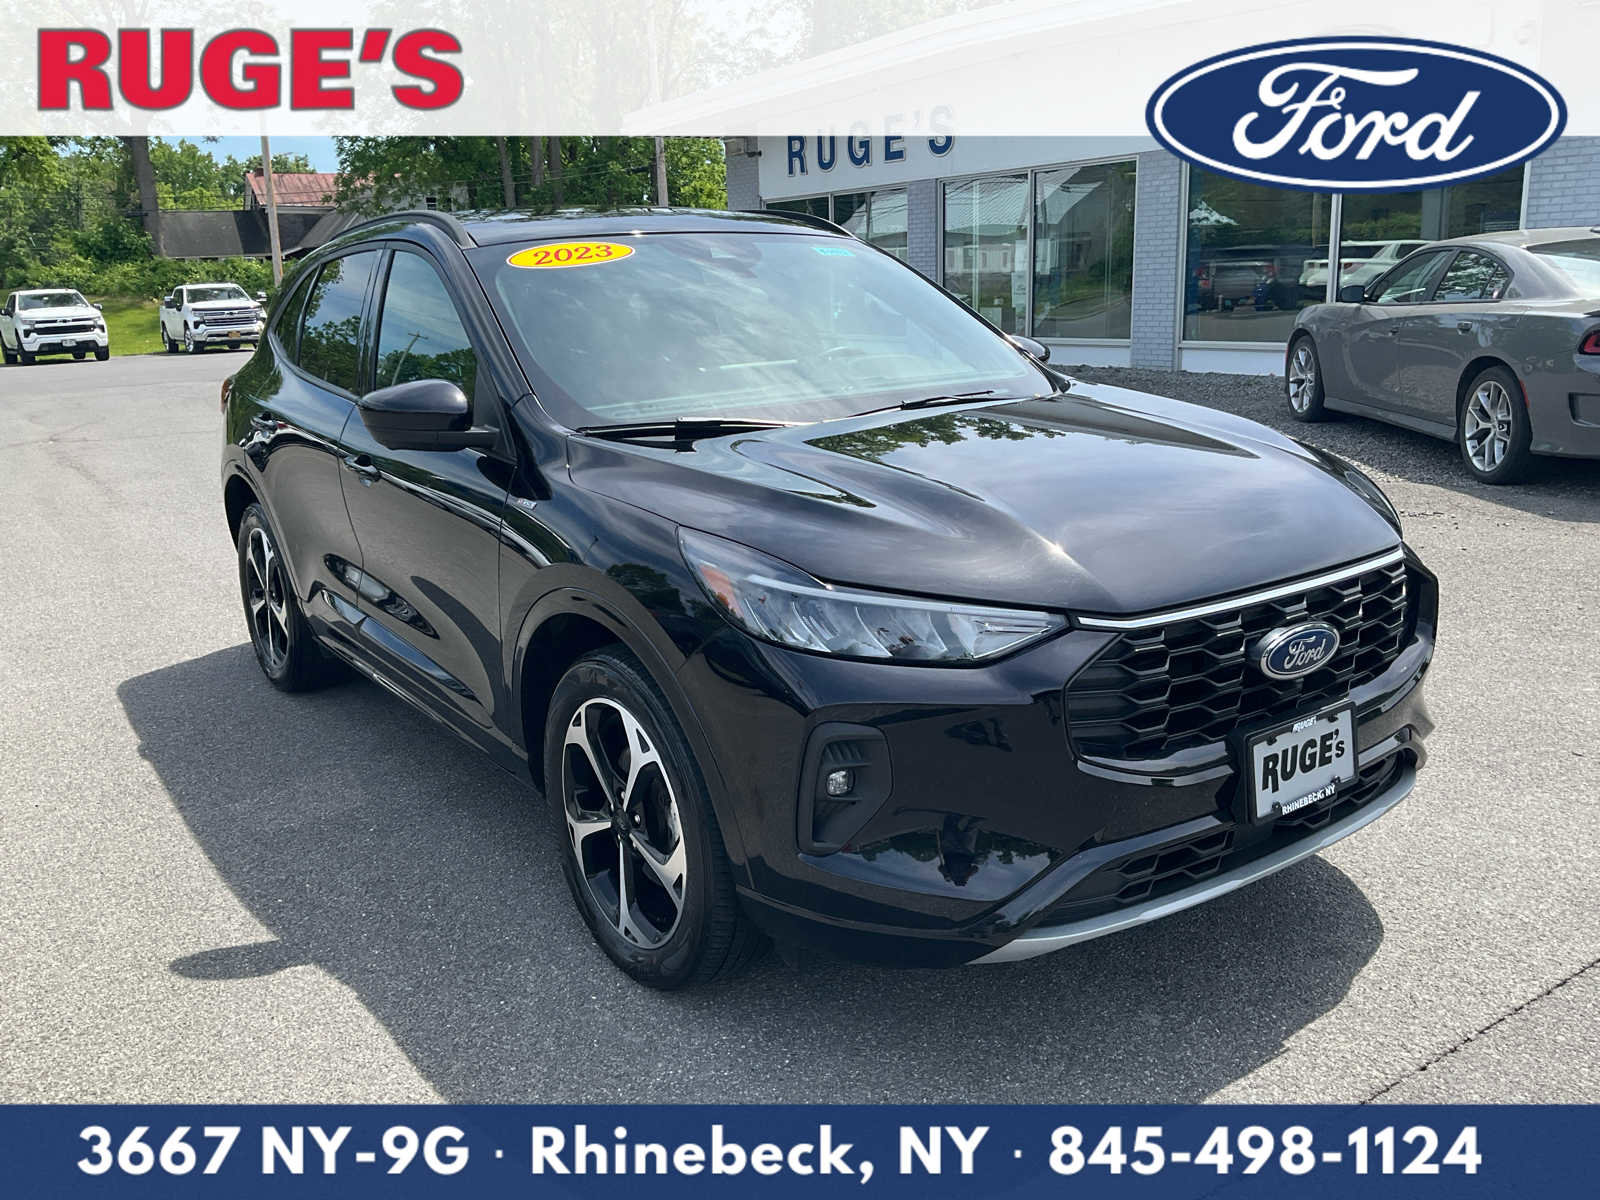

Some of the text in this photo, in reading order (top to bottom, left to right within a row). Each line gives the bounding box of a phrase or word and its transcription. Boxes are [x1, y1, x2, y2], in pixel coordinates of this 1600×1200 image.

[787, 104, 956, 177] RUGE'S
[533, 244, 613, 266] 2023
[1283, 635, 1327, 670] Ford
[1261, 728, 1345, 794] RUGE's
[1325, 782, 1336, 797] NY
